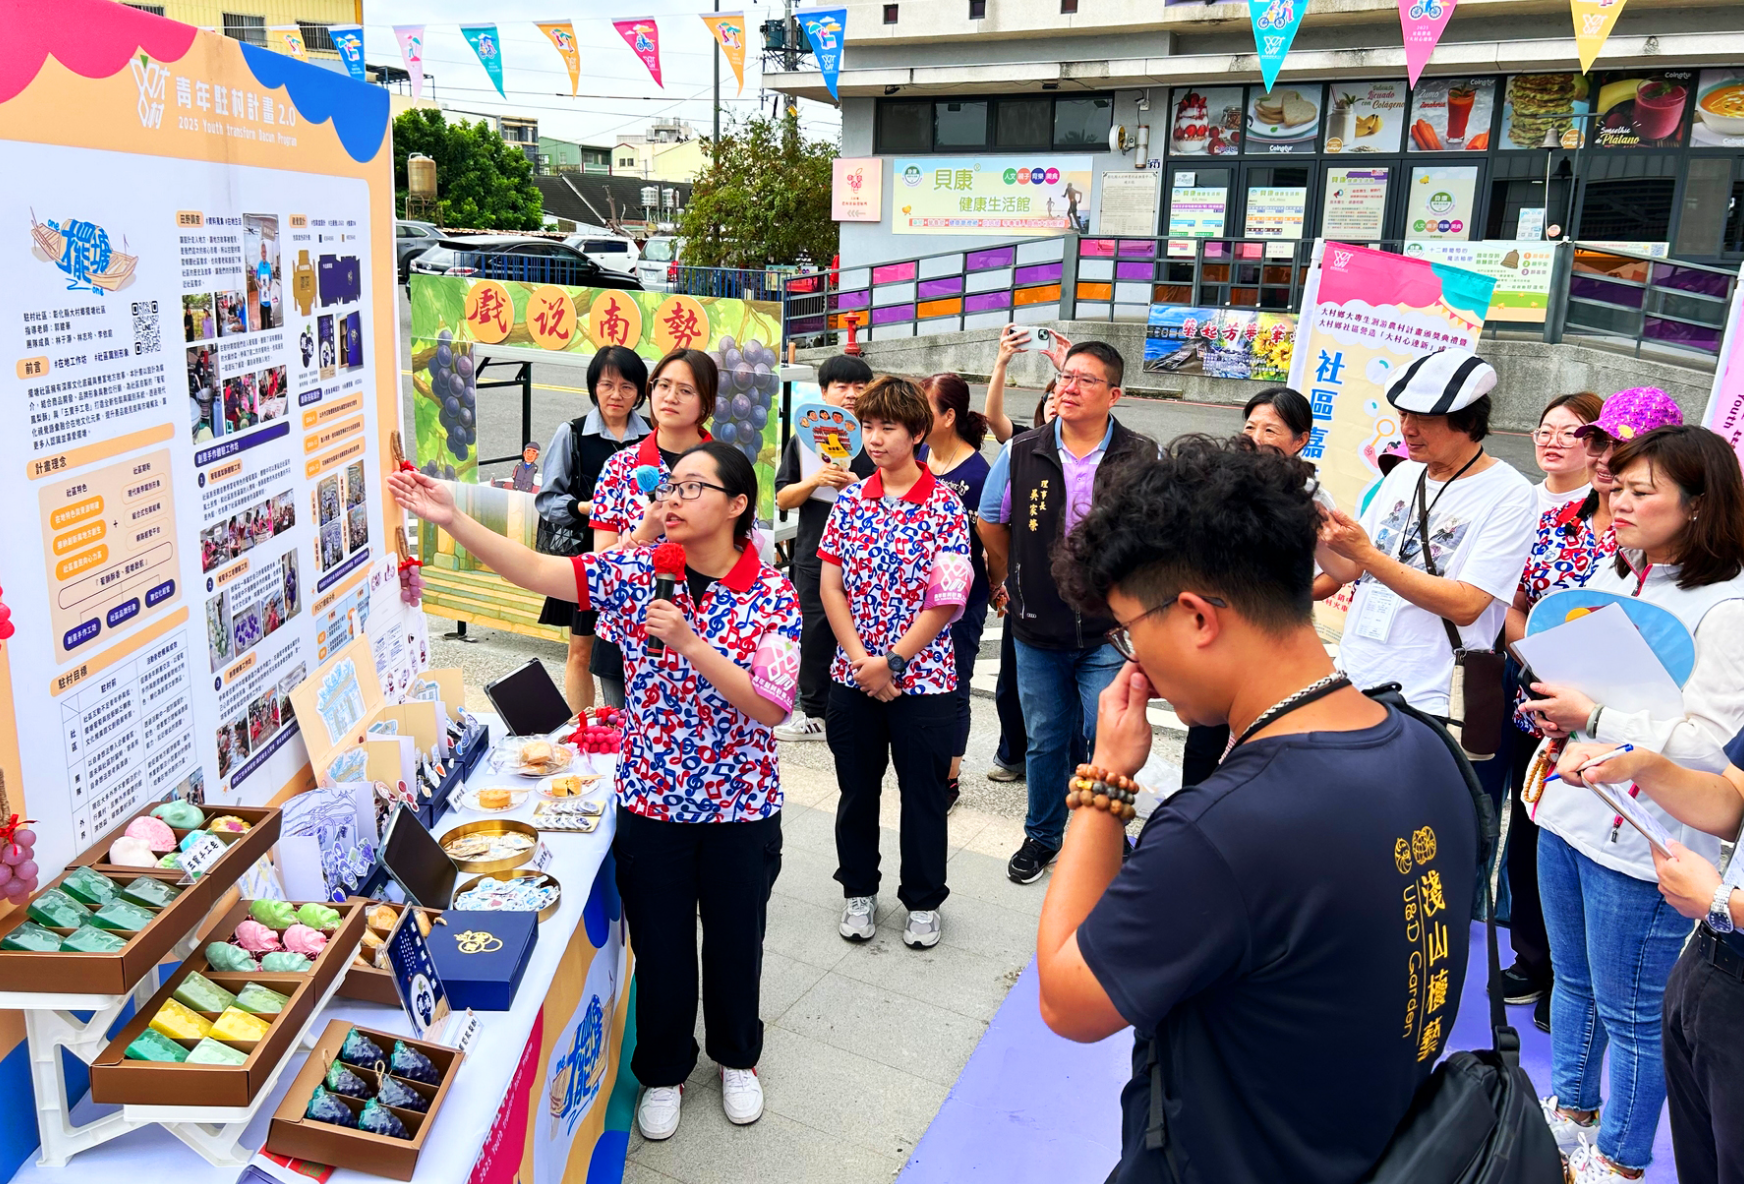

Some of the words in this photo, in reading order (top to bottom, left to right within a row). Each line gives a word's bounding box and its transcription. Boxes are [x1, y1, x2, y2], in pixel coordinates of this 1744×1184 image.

[176, 76, 274, 125] 青年駐村計畫
[278, 104, 296, 127] 2.0
[1367, 90, 1395, 100] Licuado
[1418, 89, 1439, 98] Zumo
[179, 116, 198, 131] 2025
[202, 119, 223, 136] Youth
[226, 123, 256, 140] transform
[258, 129, 275, 143] Dacun
[278, 132, 297, 147] Program
[1601, 134, 1640, 144] Plátano
[934, 169, 973, 191] 貝康
[1004, 172, 1016, 180] 人文
[1018, 172, 1030, 180] 親子
[1046, 172, 1058, 180] 美食
[959, 197, 1031, 213] 健康生活館
[48, 219, 61, 231] one
[92, 286, 104, 296] one
[25, 362, 41, 374] 前言
[54, 355, 87, 368] #在地工作坊
[1302, 350, 1345, 472] 社區嘉
[35, 456, 67, 475] 計畫理念
[66, 484, 87, 497] 社區特色
[1040, 480, 1049, 511] 理事長
[58, 665, 88, 690] 駐村目標
[101, 678, 117, 693] 駐村前
[1403, 950, 1422, 1038] Garden
[479, 1157, 492, 1183] 2025
[491, 1130, 503, 1155] Youth
